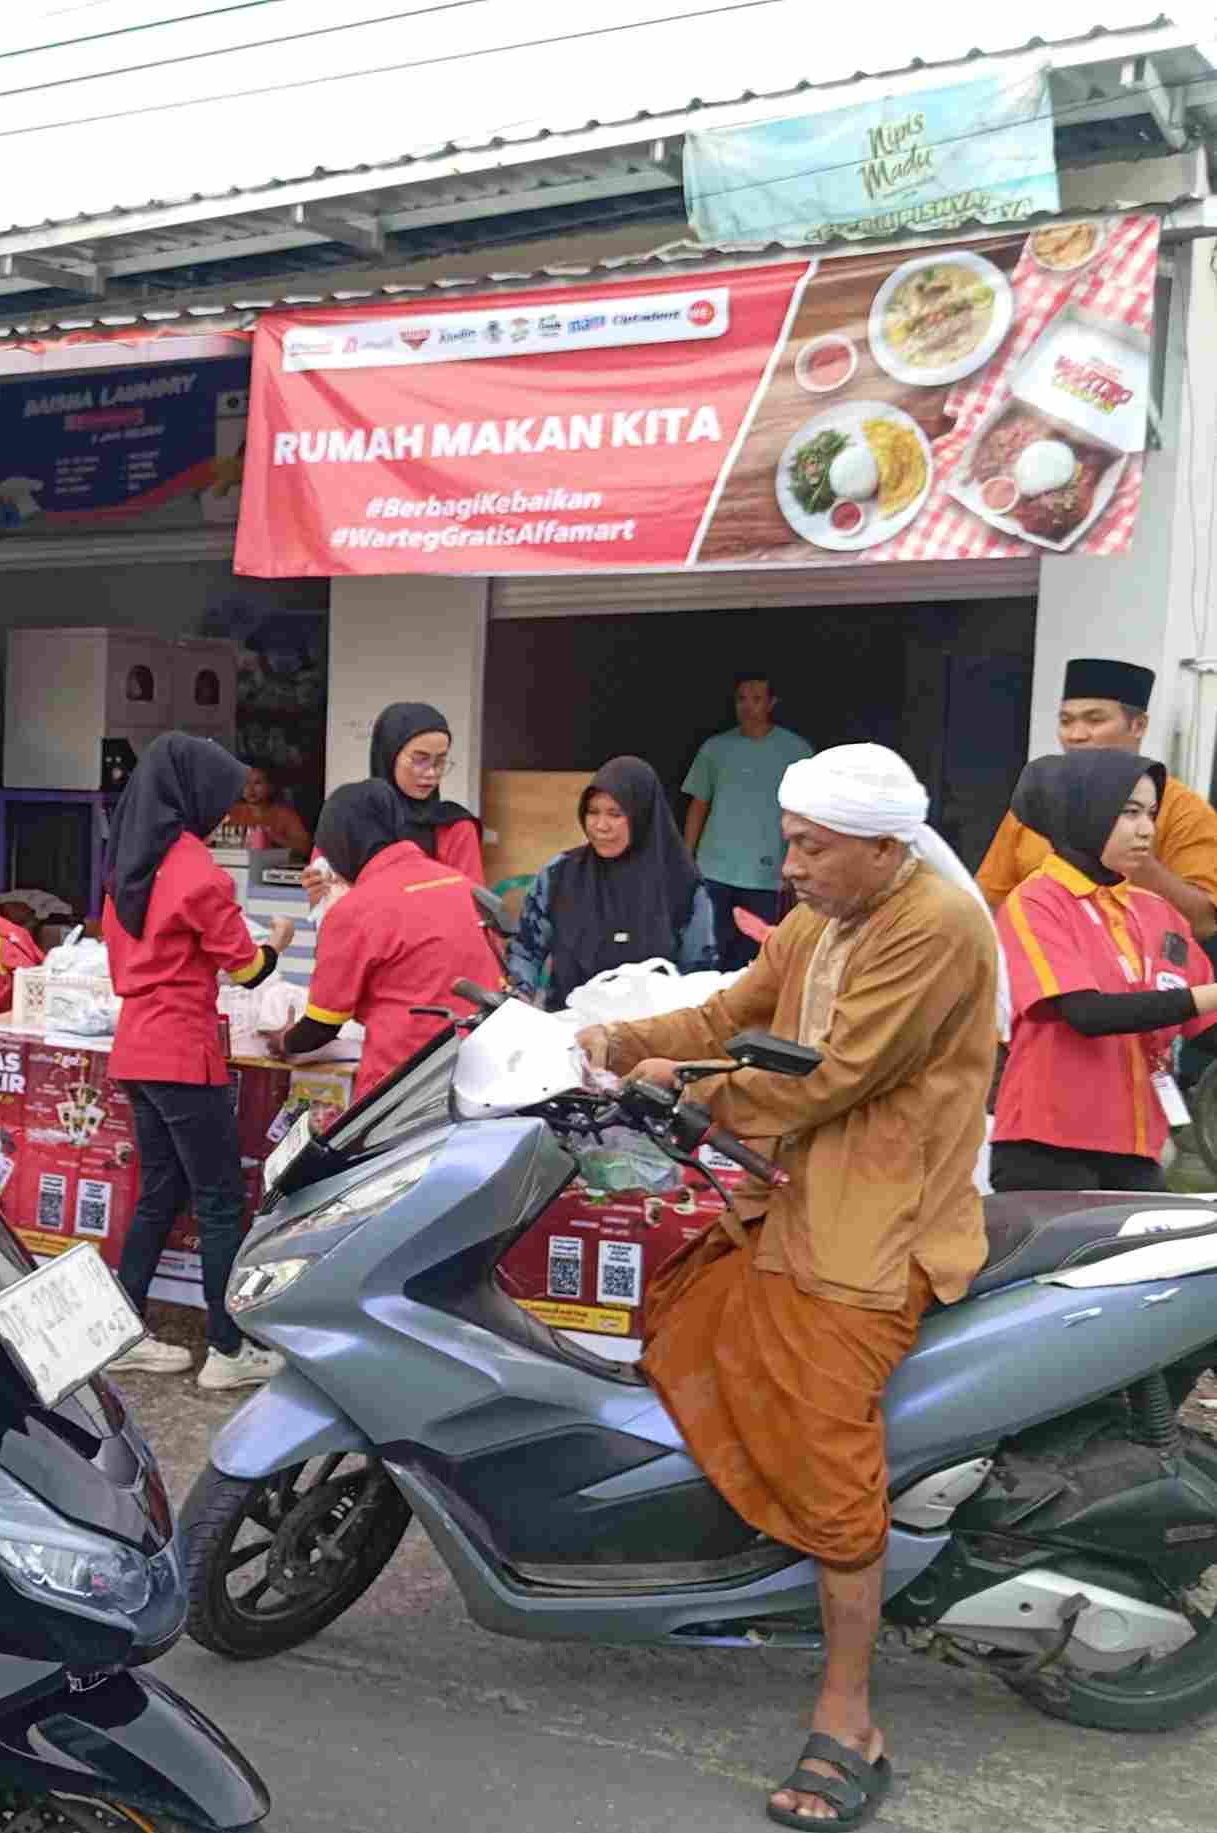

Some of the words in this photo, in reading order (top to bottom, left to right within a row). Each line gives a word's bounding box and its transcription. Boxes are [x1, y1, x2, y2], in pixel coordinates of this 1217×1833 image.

[273, 424, 424, 466] RUMAH
[430, 414, 604, 458] MAKAN
[610, 405, 722, 447] KITA
[366, 488, 603, 521] #BerbagiKebaikan
[330, 518, 637, 552] #WartegGratisAlfamart
